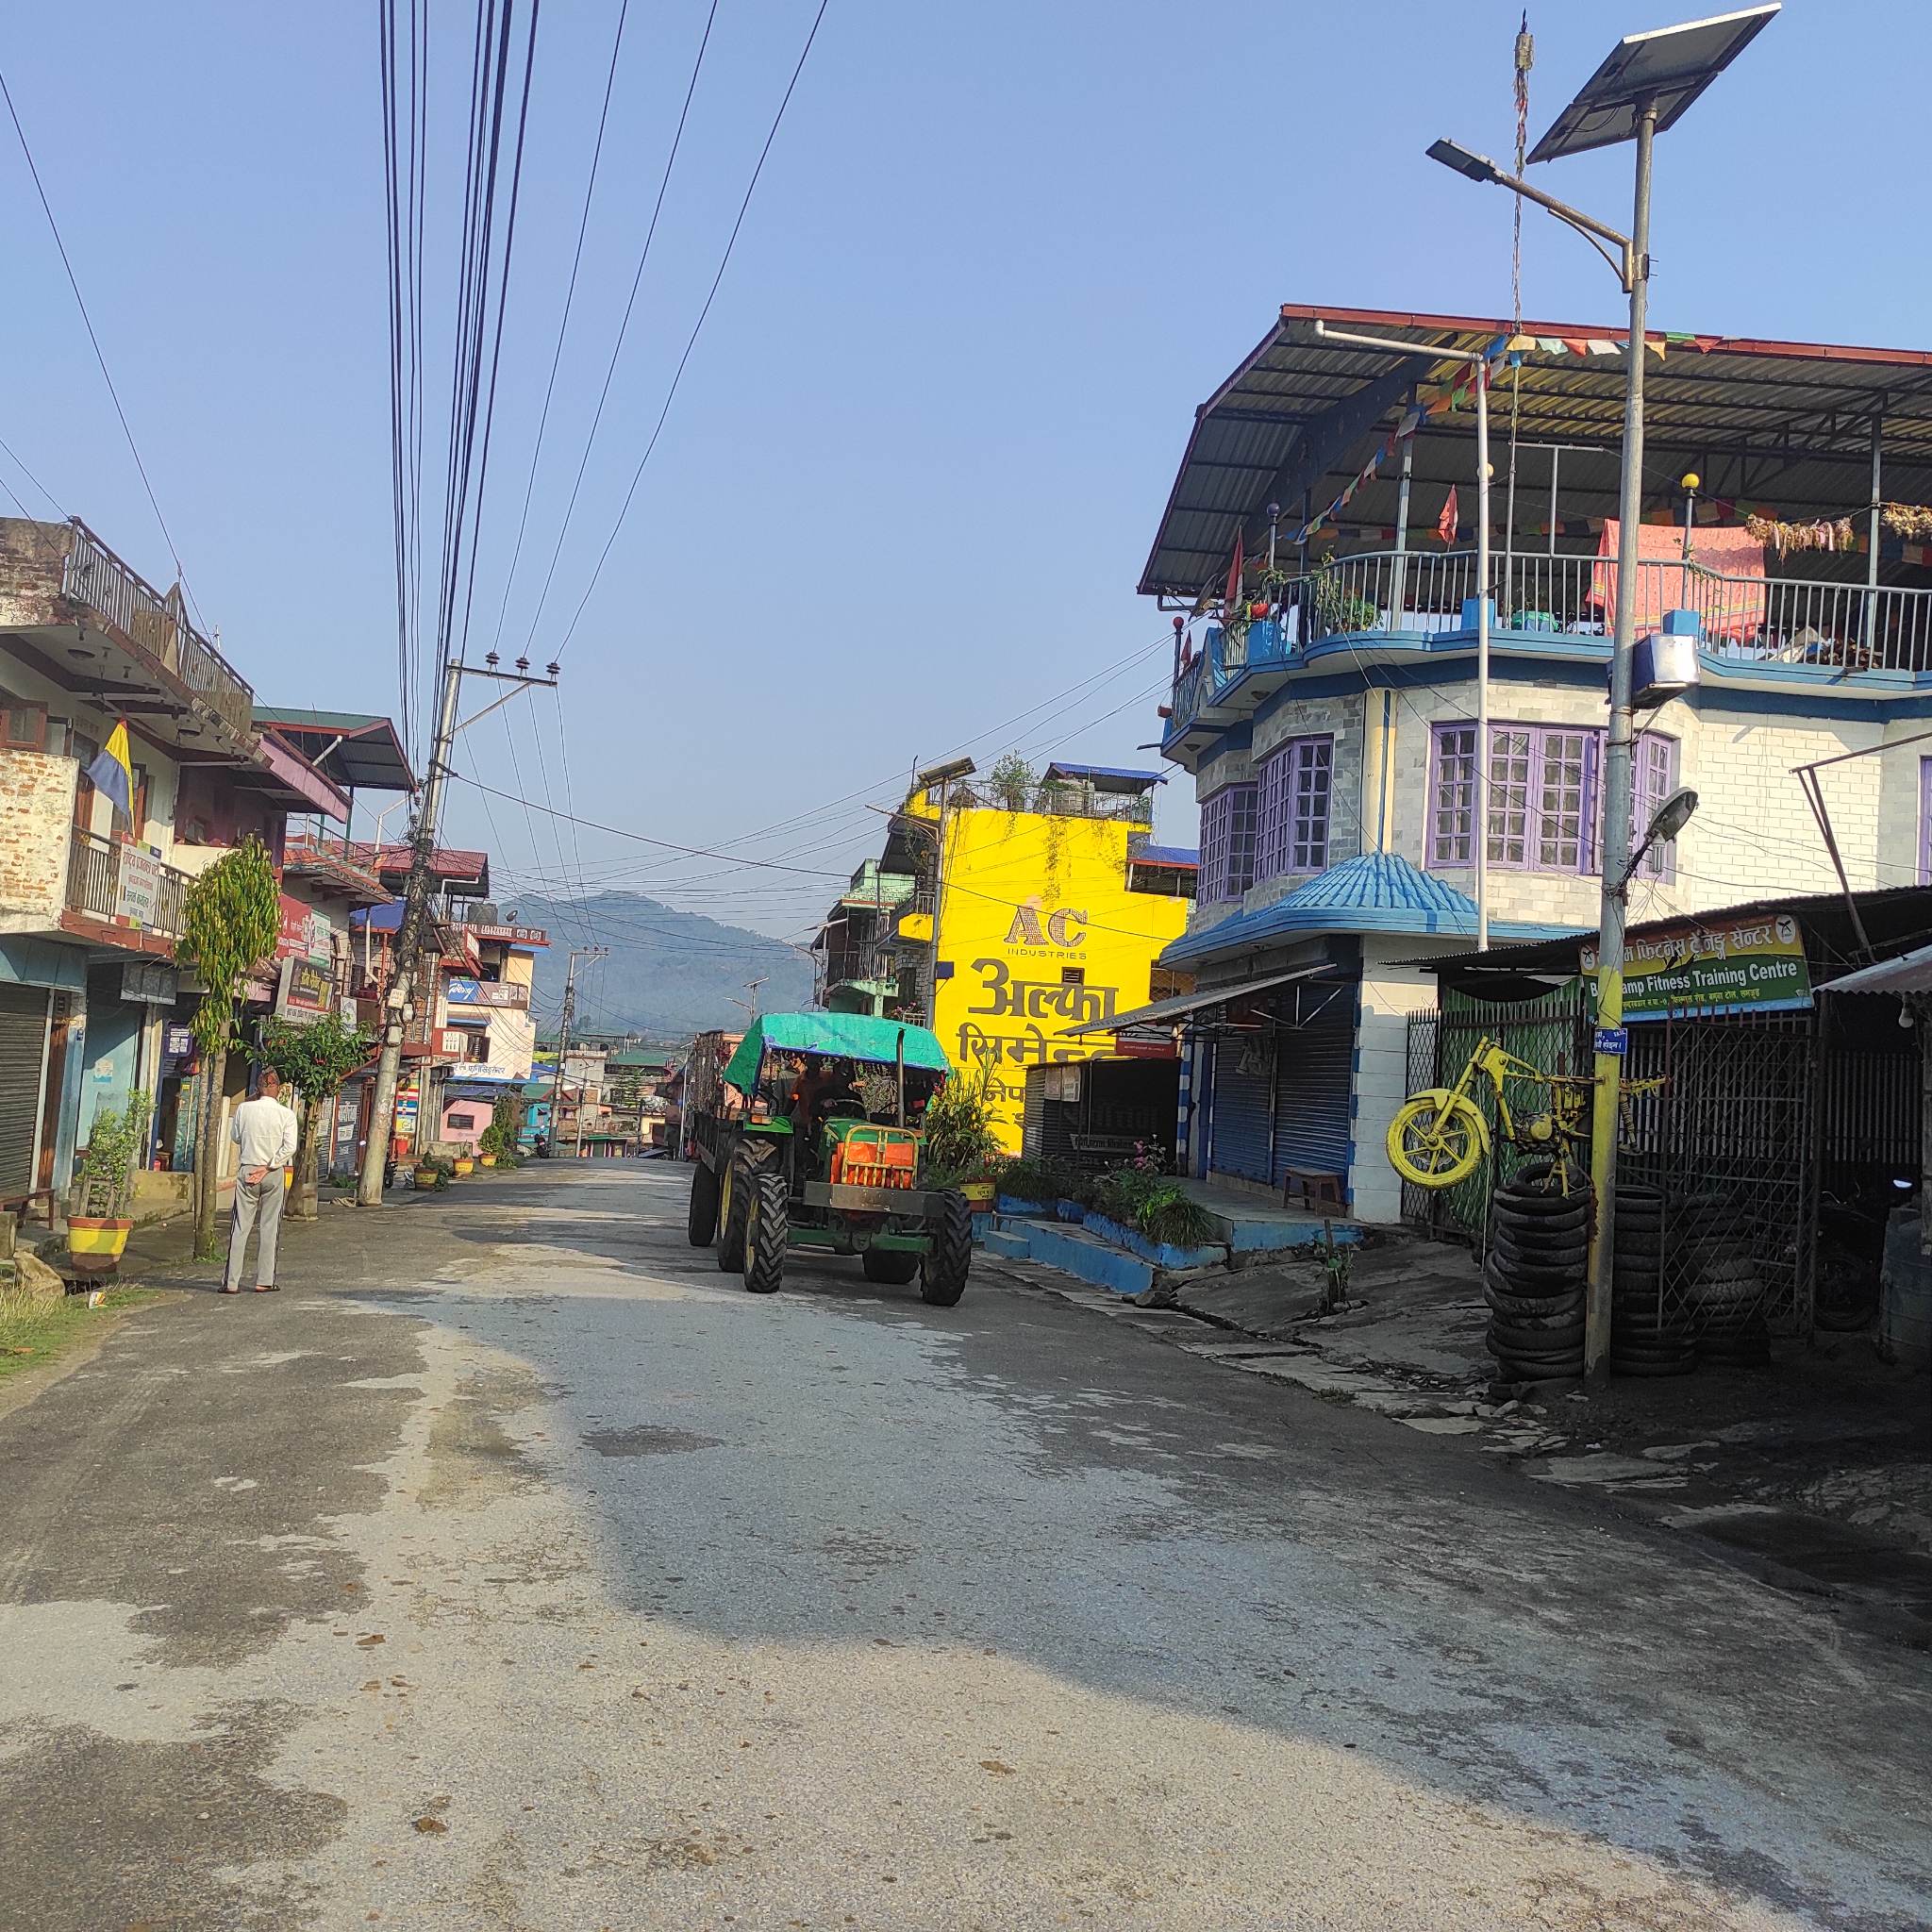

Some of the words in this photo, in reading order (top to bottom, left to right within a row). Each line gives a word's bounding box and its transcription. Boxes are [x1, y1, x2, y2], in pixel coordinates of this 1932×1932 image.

[1003, 906, 1088, 947] AC
[1729, 924, 1774, 949] सेन्टर
[1007, 948, 1087, 959] INDUSTRIES
[1646, 975, 1690, 991] Fitness
[1692, 967, 1747, 987] Training
[1749, 960, 1797, 981] Centre
[956, 1022, 1116, 1065] सिमे
